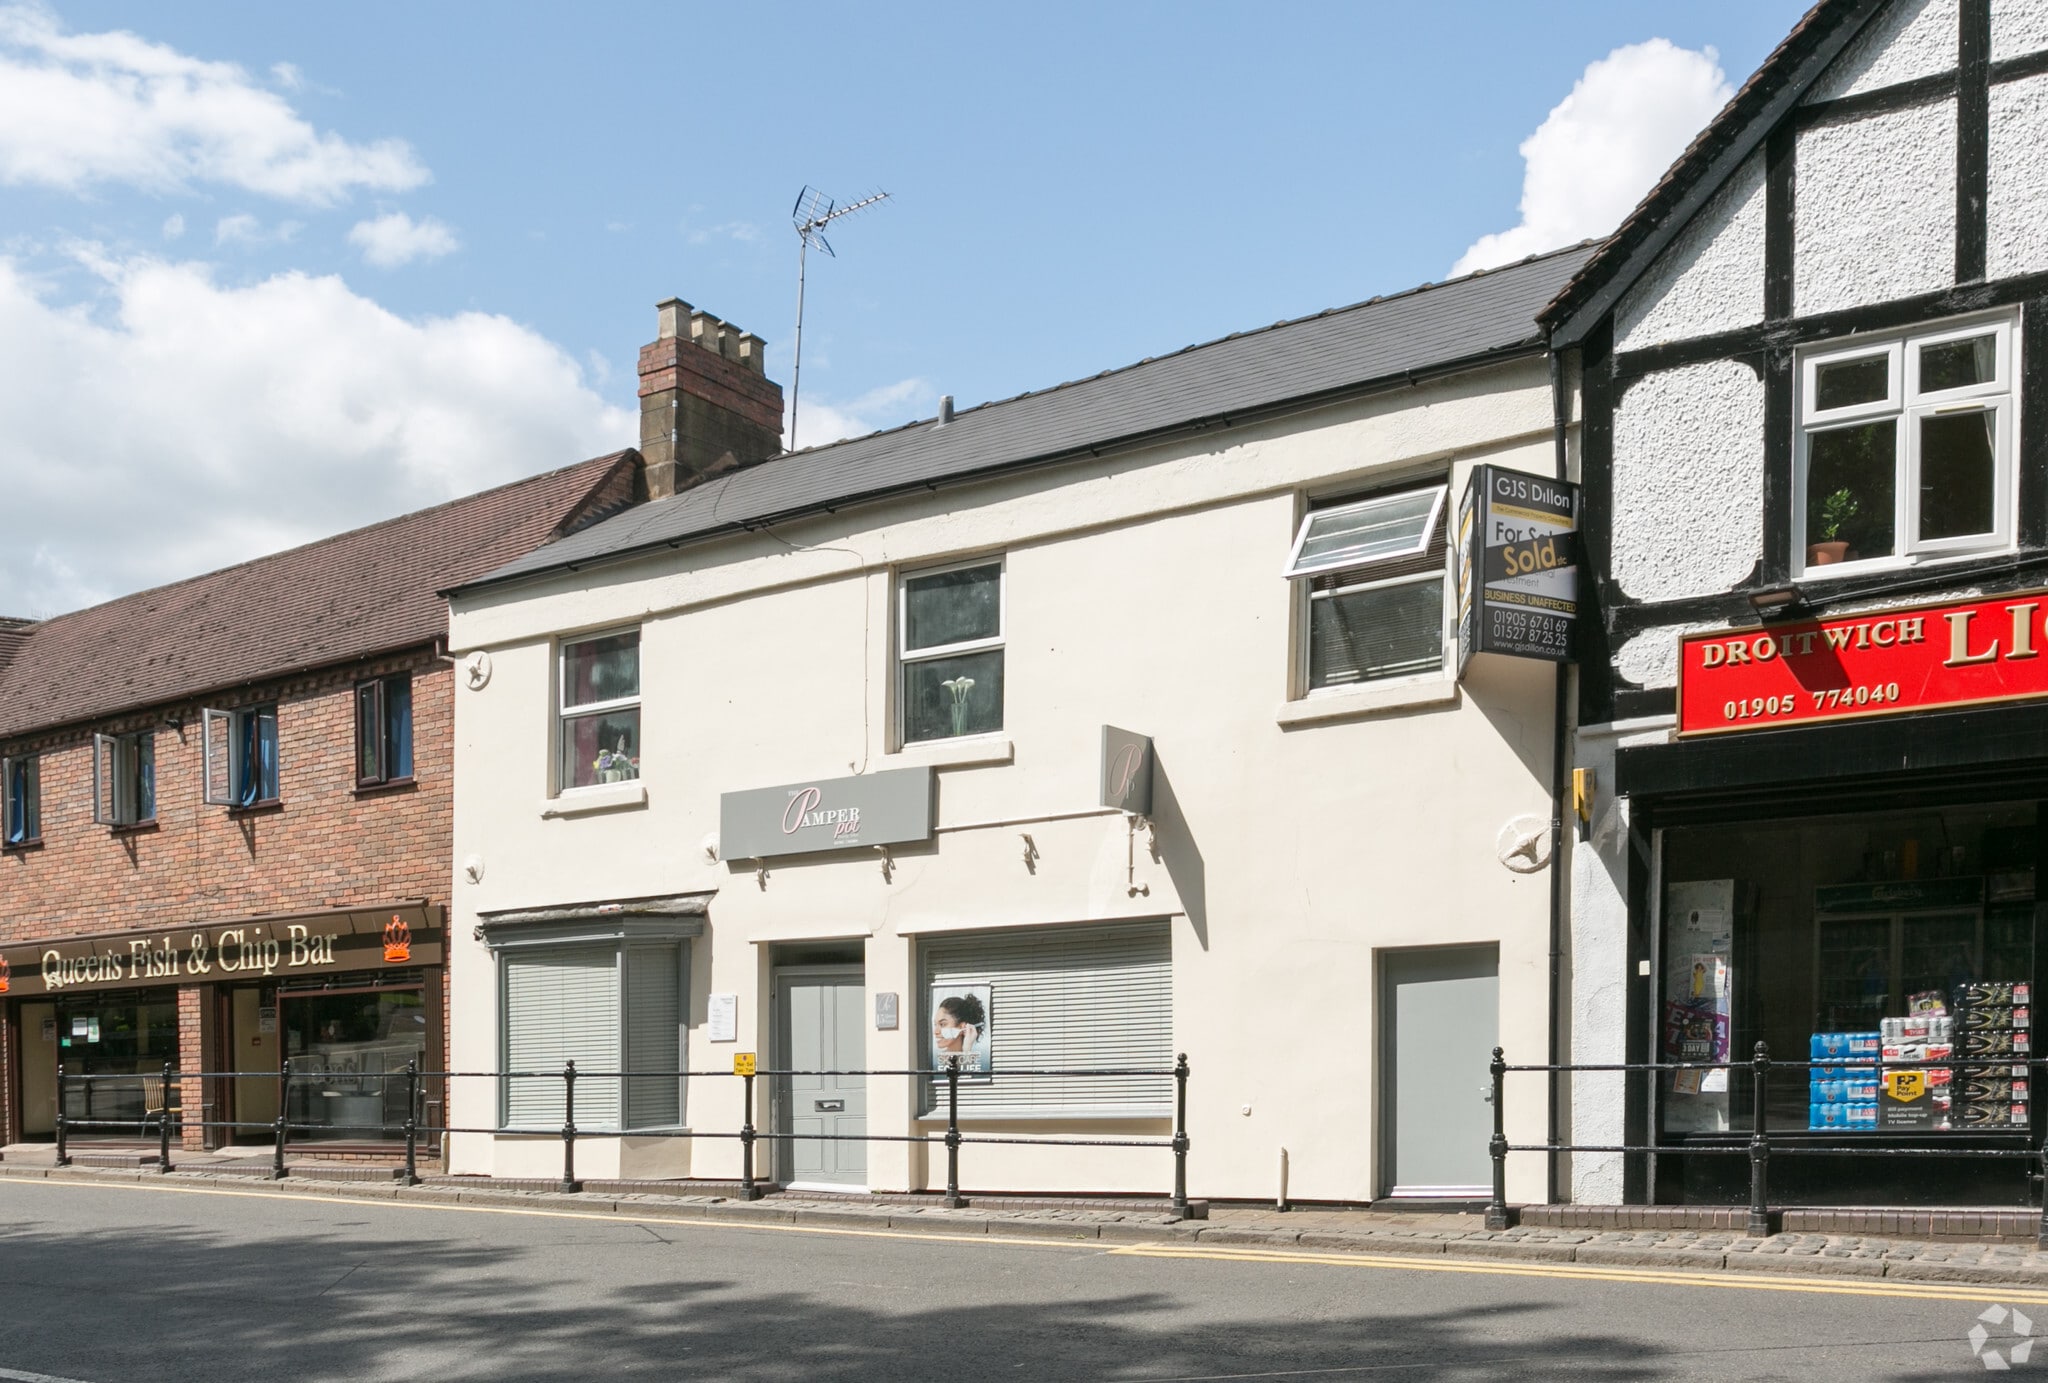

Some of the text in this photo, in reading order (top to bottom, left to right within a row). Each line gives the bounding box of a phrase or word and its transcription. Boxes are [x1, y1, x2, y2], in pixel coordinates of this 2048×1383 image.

[1496, 477, 1570, 509] GJS Dillon
[1496, 521, 1523, 543] For
[1503, 538, 1557, 576] Sold
[1485, 589, 1576, 612] BUSINESS UNAFFECTED
[1493, 624, 1526, 640] 01527
[1494, 610, 1526, 627] 01905
[1493, 640, 1567, 656] www.gjsdillon.co.uk
[1702, 617, 1925, 668] DROITWICH
[1942, 602, 2048, 669] LI
[1724, 682, 1900, 720] 01905 774040
[834, 819, 861, 840] pot
[129, 937, 180, 979] Fish
[187, 933, 211, 975] &
[218, 928, 279, 976] Chip
[287, 924, 338, 967] Bar
